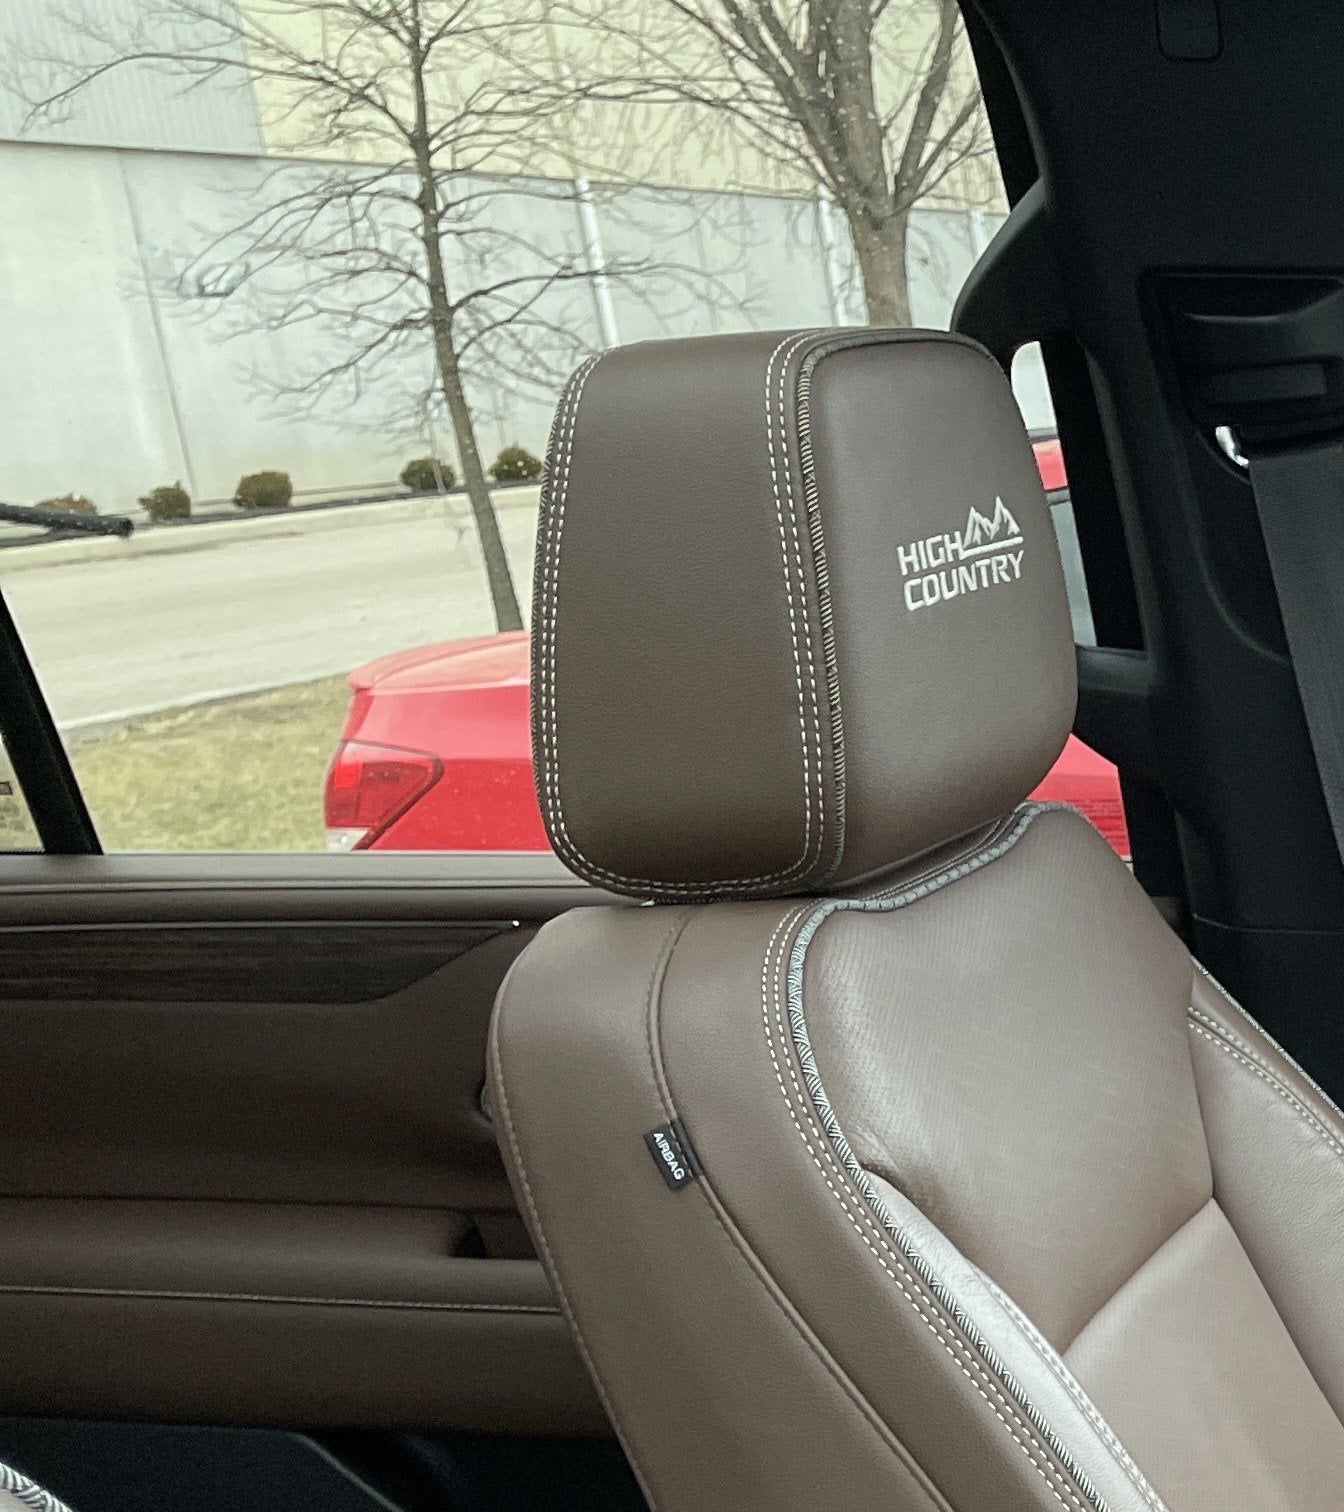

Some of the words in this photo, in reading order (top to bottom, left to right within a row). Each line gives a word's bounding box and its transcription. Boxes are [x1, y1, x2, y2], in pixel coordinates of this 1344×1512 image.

[897, 530, 966, 576] HIGH
[903, 550, 1024, 612] COUNTRY
[653, 1132, 685, 1180] AIRBAG
